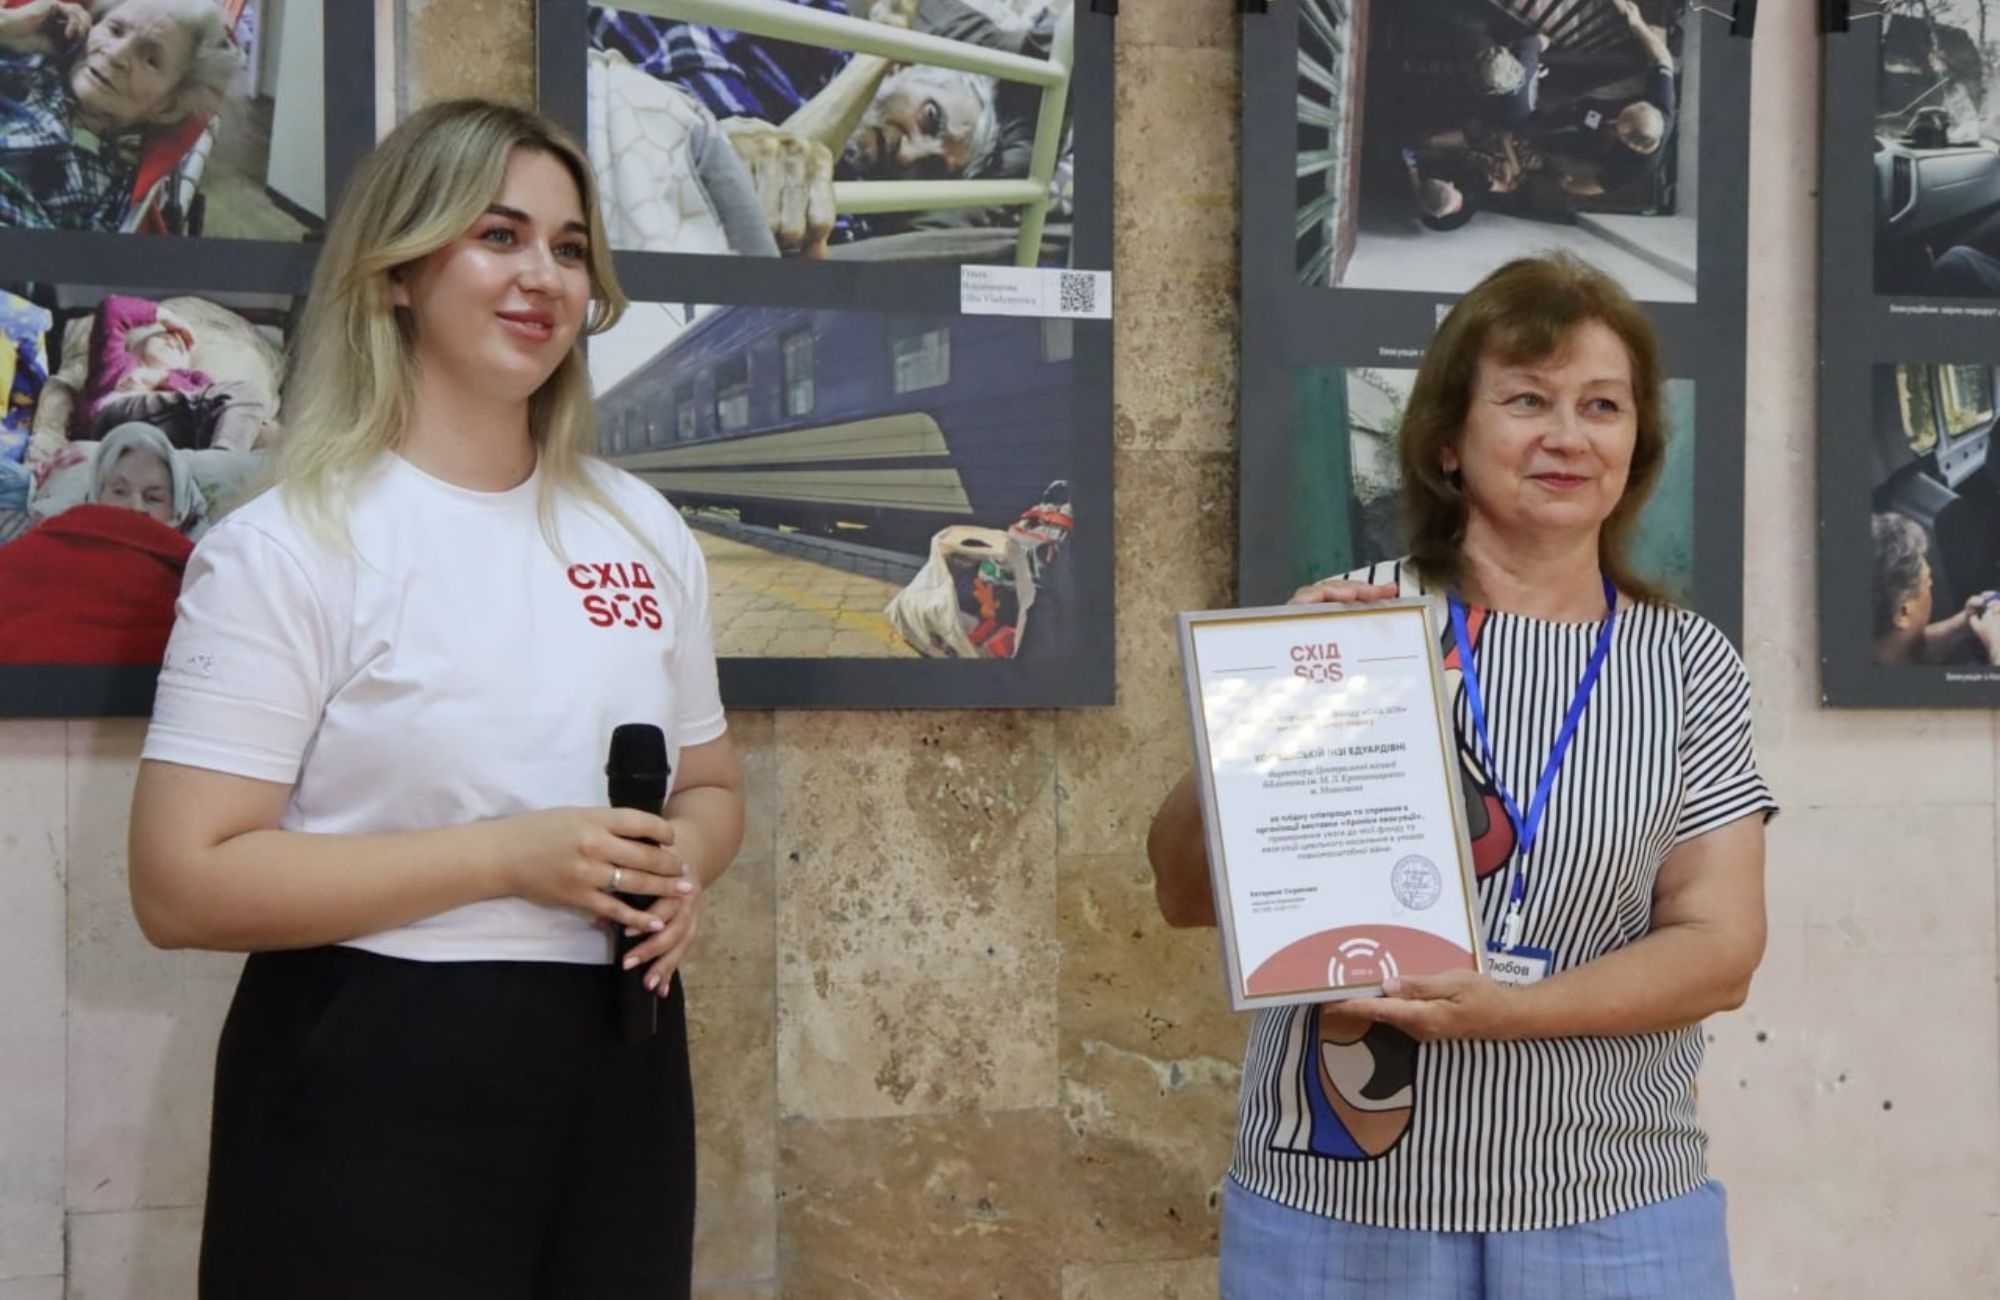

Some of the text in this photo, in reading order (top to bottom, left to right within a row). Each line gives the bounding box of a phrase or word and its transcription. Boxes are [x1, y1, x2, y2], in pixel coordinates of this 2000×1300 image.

[567, 561, 656, 590] СХІД
[583, 593, 663, 631] SOS
[1290, 642, 1342, 662] СХІД
[1293, 662, 1344, 684] SOS
[1348, 741, 1407, 756] ЕДУАРДІВНІ
